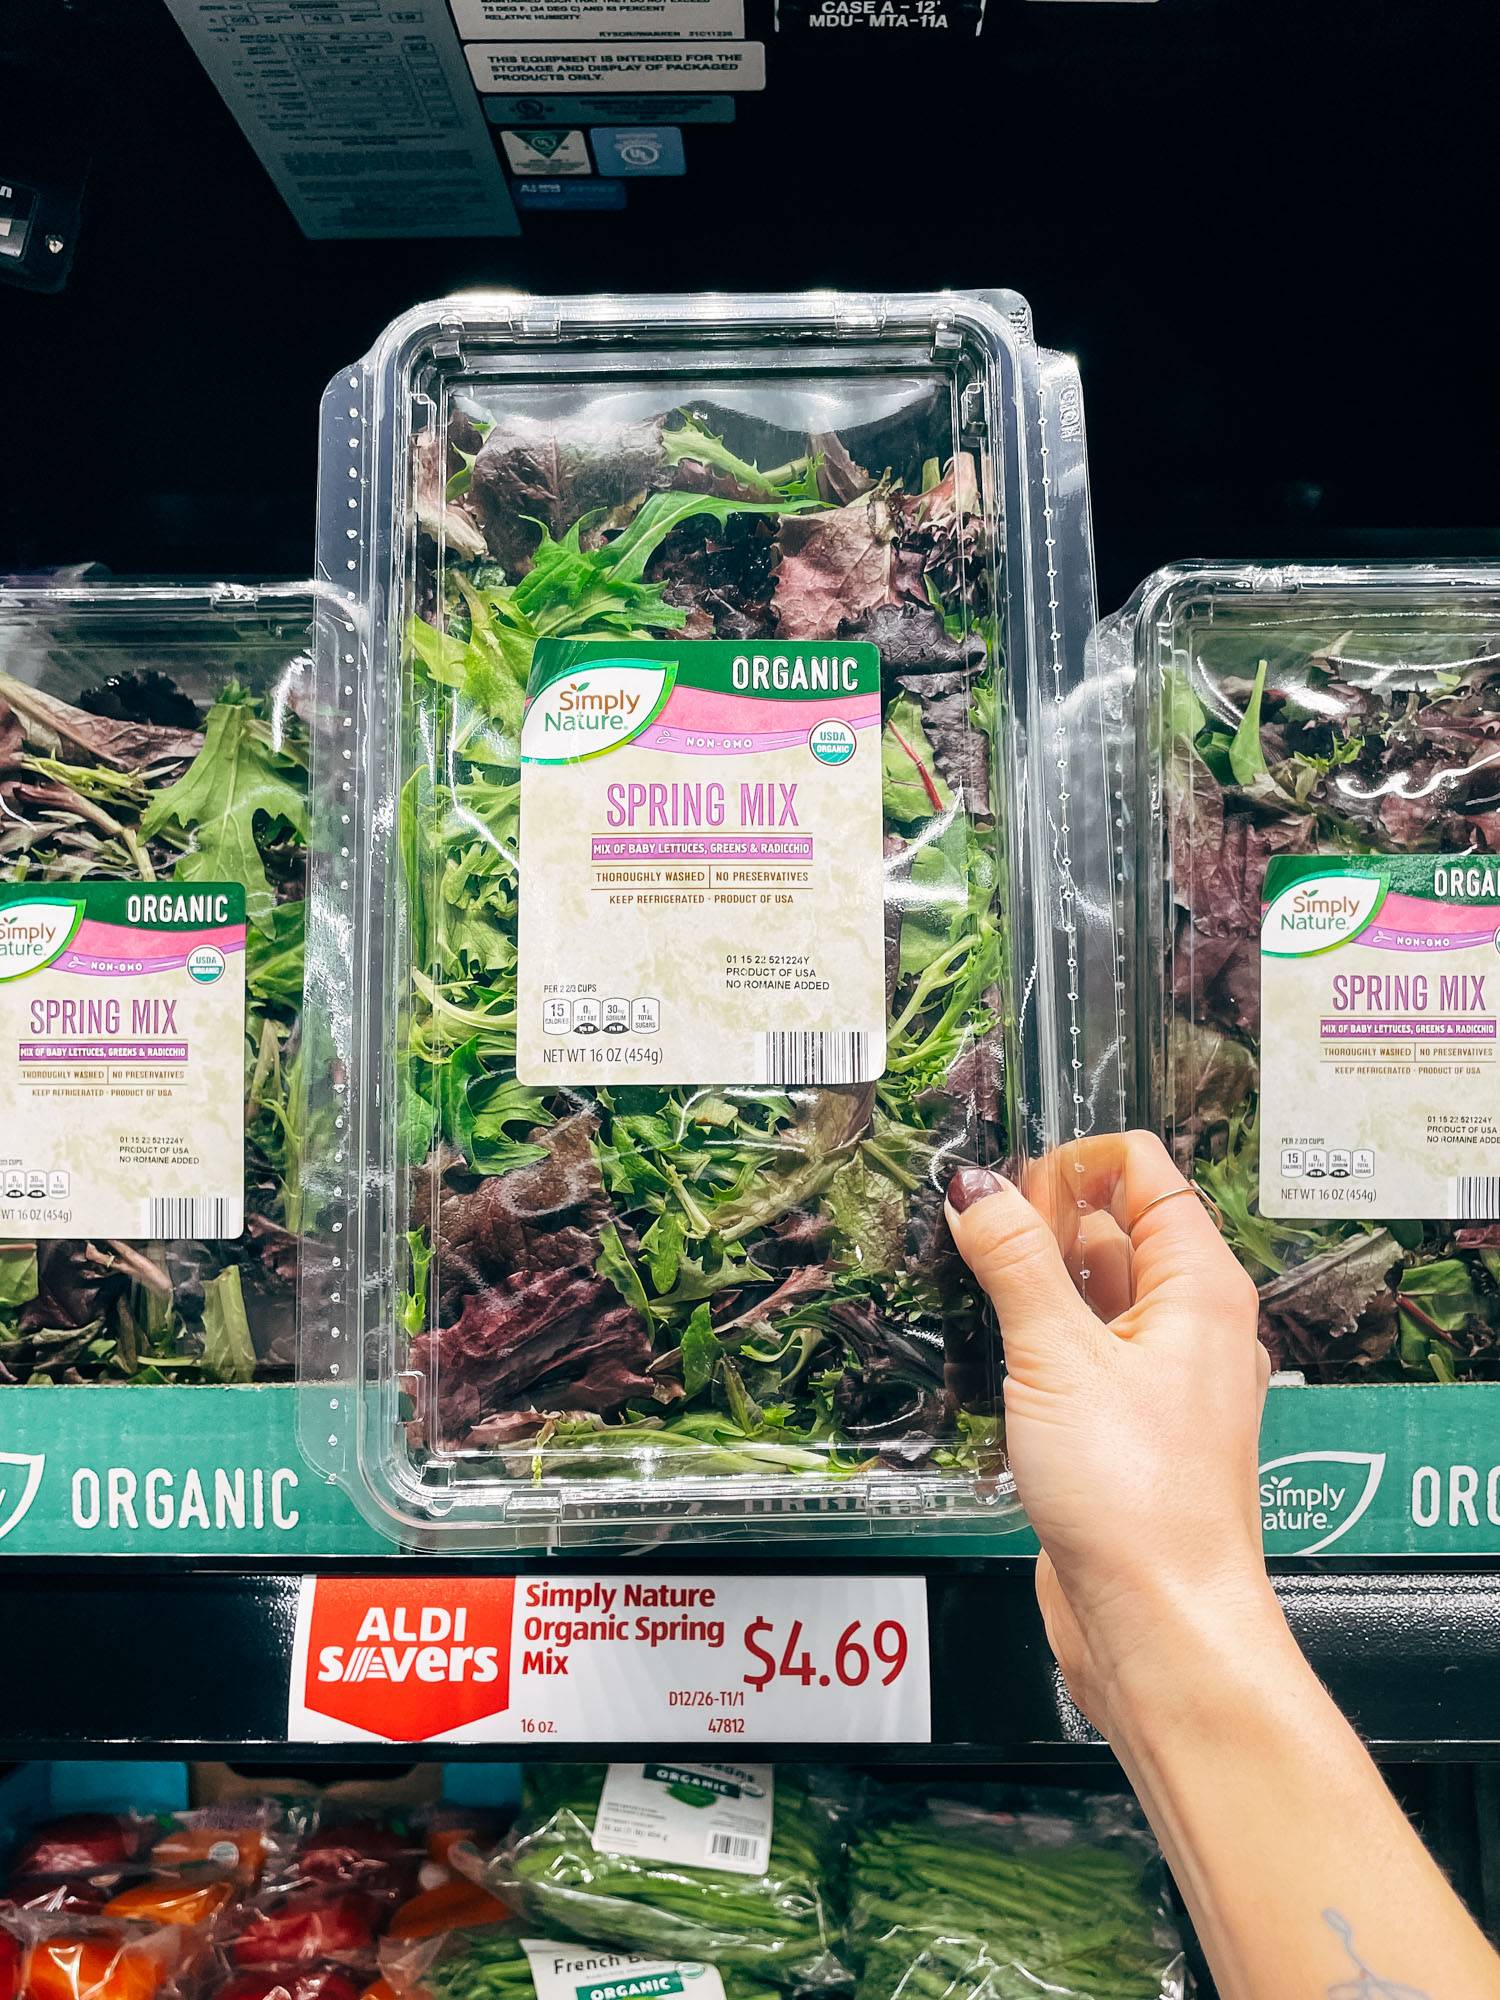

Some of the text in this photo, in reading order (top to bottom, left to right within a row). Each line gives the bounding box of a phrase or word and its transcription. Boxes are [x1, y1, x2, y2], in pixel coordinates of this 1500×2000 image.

[821, 1, 941, 14] CASE A 12'
[809, 14, 949, 28] MDU- MTA-11A
[731, 655, 859, 691] ORGANIC
[559, 689, 640, 715] Simply
[686, 737, 753, 749] NON-GMO
[820, 731, 846, 741] USDA
[816, 744, 850, 754] ORGANIC
[606, 782, 800, 827] SPRING MIX
[593, 842, 809, 855] MIX OF BABY LETTUCES, GREENS & RADICCHIO
[596, 872, 705, 882] THOROUGHLY WASHED
[716, 871, 809, 882] NO PRESERVATIVES
[609, 895, 794, 904] KEEP REFRIGERATED PRODUCT OF USA
[127, 894, 229, 924] ORGANIC
[1293, 896, 1360, 918] Simply
[0, 941, 43, 956] ature
[1396, 936, 1451, 947] NON-GMO
[90, 961, 143, 972] NON-GMO
[195, 956, 217, 964] USDA
[726, 955, 810, 965] 01 15 521224Y
[726, 968, 816, 977] PRODUCT OF USA
[543, 984, 597, 993] PER 2/3 CUPS
[726, 980, 830, 990] NO ROMAINE ADDED
[1332, 975, 1486, 1011] SPRING MIX
[30, 999, 177, 1034] SPRING MIX
[550, 1003, 564, 1017] 15
[1322, 1024, 1494, 1034] MIX OF BABY LETTUCES, GREENS & RADICCHIO
[20, 1048, 186, 1057] MIX OF BABY LETTUCES, GREENS & RADICCHIO
[543, 1047, 663, 1065] NET WT 16 OZ (454g)
[1324, 1048, 1412, 1056] THOROUGHLY WASHED
[1420, 1048, 1493, 1056] NO PRESERVATIVES
[22, 1071, 104, 1079] THOROUGHLY WASHED
[112, 1071, 184, 1079] NO PRESERVATIVES
[32, 1089, 173, 1097] KEEP REFRIGERATED PRODUCT OF USA
[120, 1146, 158, 1154] PRODUCT
[133, 1156, 169, 1164] ROMAINE
[1288, 1152, 1299, 1164] 15
[1281, 1188, 1377, 1203] NET WT 16 OZ (454g)
[1, 1209, 72, 1223] WT 16 OZ (454g)
[71, 1467, 300, 1530] ORGANIC
[1259, 1482, 1346, 1512] Simply
[1262, 1508, 1328, 1530] ature
[526, 1583, 716, 1614] Simply Nature
[356, 1607, 466, 1642] ALDI
[525, 1616, 725, 1647] Organic Spring
[743, 1615, 909, 1693] $4.69
[522, 1651, 568, 1676] Mix
[669, 1691, 745, 1708] D12/26-T1/1
[522, 1719, 558, 1733] 16 oz.
[708, 1718, 745, 1733] 47812
[656, 1769, 728, 1793] ORGANIC
[554, 1954, 620, 1975] French
[590, 1978, 671, 2000] ORGANIC
